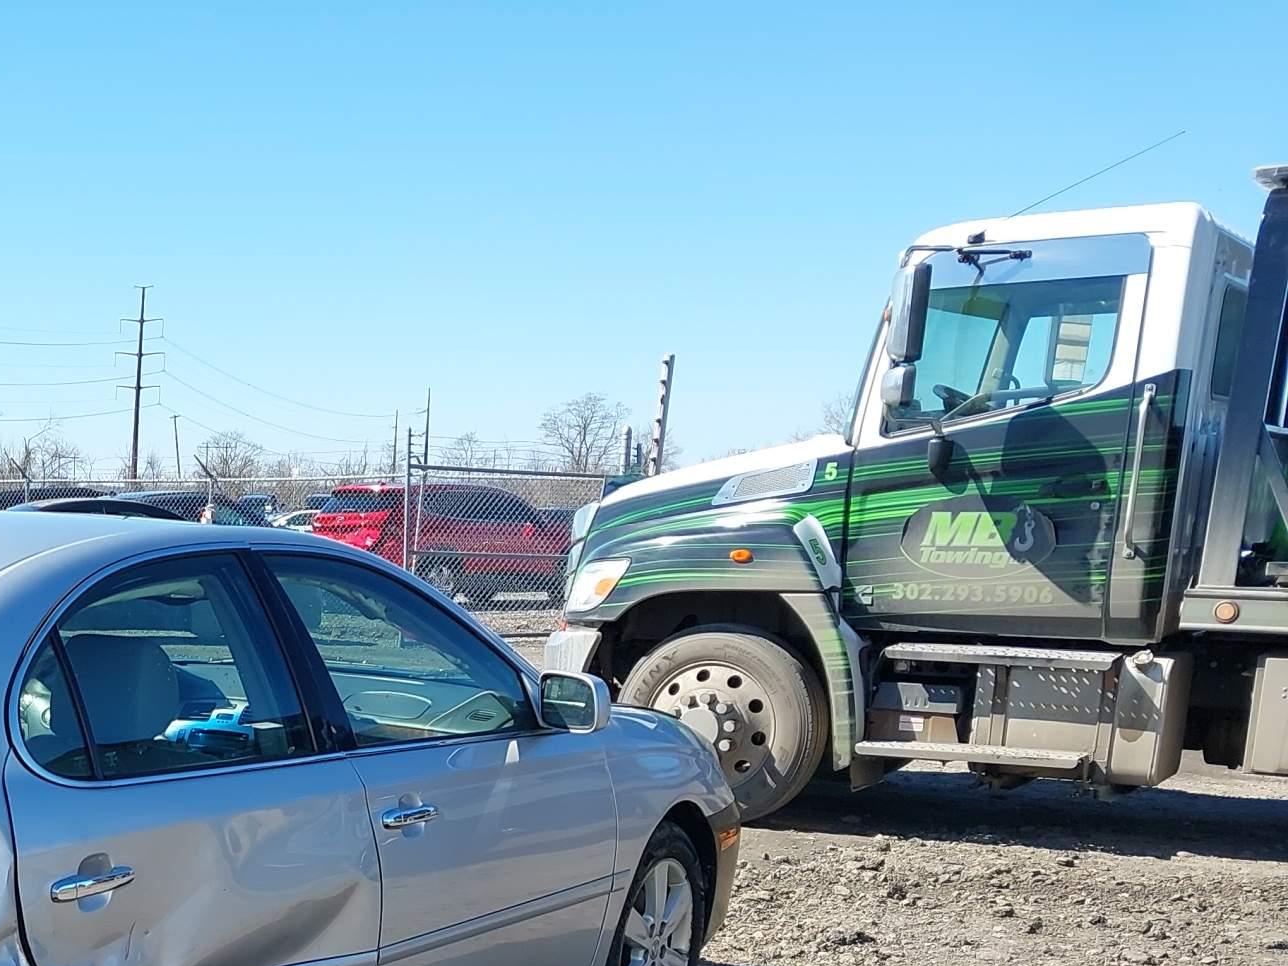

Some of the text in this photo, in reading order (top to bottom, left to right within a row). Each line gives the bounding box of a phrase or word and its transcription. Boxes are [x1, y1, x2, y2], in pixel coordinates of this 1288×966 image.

[824, 462, 838, 481] 5
[920, 511, 1018, 547] MB
[809, 538, 827, 566] 5
[919, 547, 1009, 568] Towing
[891, 583, 1053, 604] 302.293.5906
